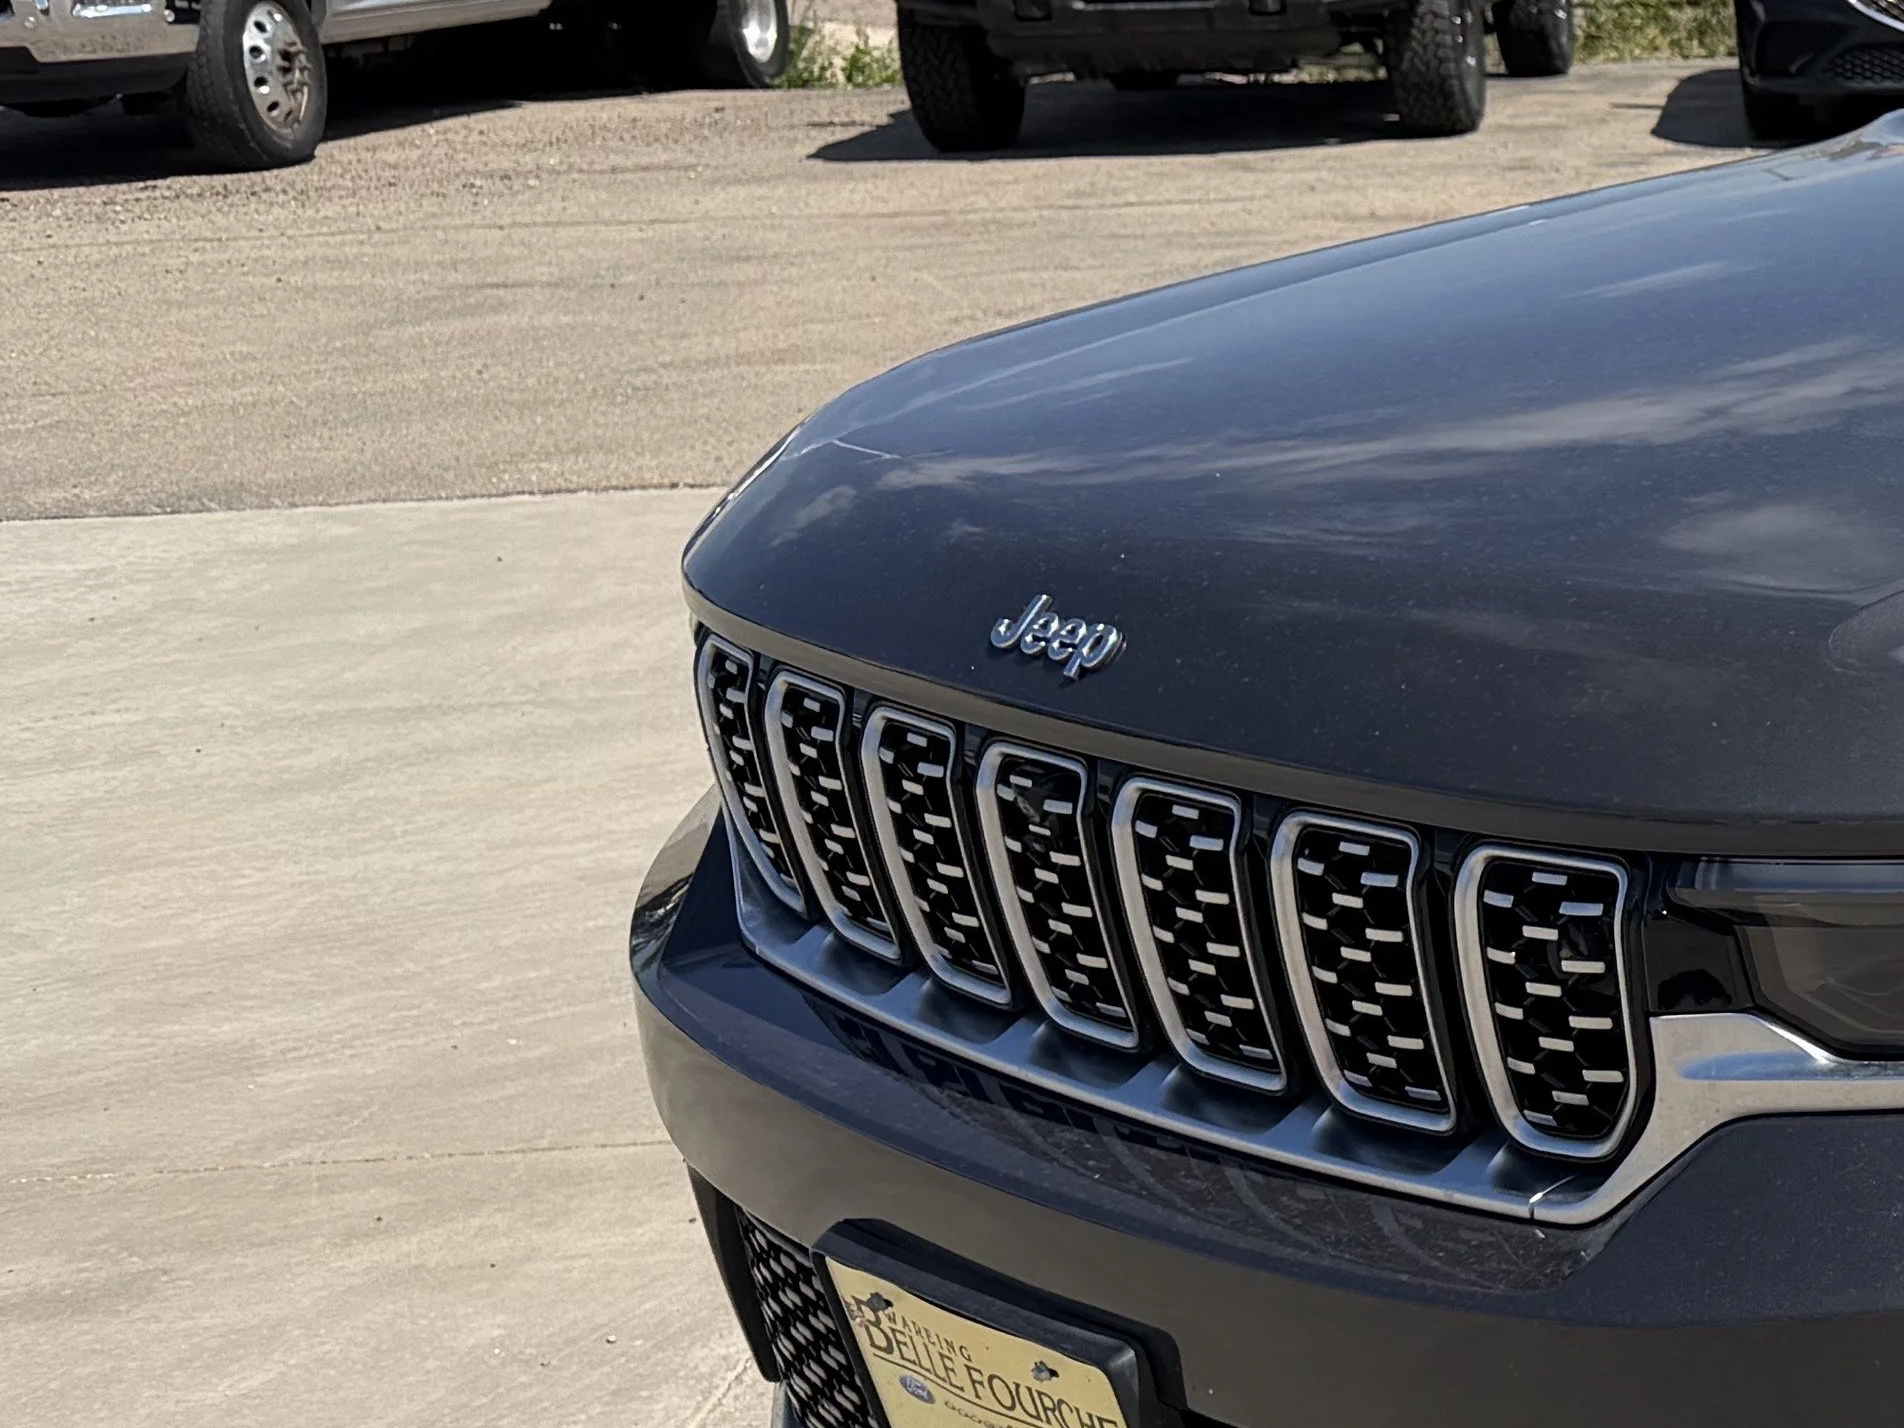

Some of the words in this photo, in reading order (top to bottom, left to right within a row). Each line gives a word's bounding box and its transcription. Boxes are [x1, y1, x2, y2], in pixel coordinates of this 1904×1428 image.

[990, 594, 1119, 680] Jeep
[851, 1294, 965, 1393] BELLE
[884, 1311, 972, 1363] WAREING
